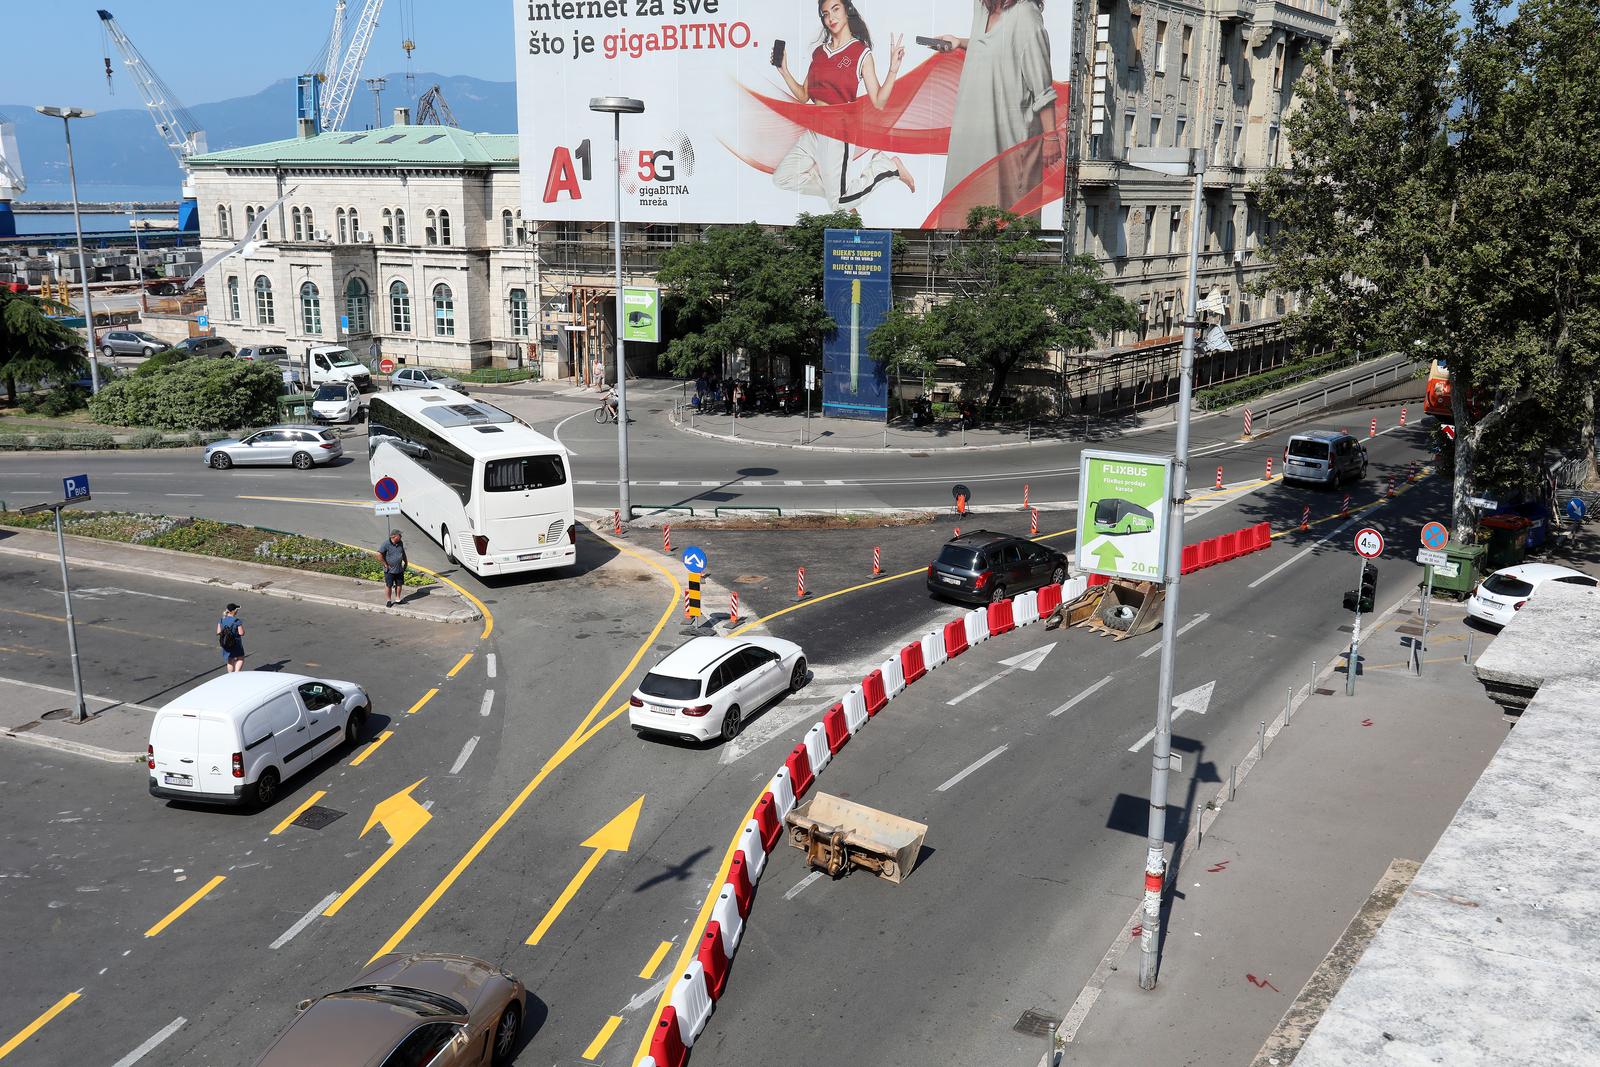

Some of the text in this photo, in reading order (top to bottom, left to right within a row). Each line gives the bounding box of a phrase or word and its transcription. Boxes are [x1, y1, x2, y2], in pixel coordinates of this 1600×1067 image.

[528, 0, 719, 20] internet za sve
[529, 22, 759, 60] što je gigaBITNO.
[543, 138, 592, 204] A1
[637, 150, 675, 182] 5G
[639, 185, 690, 196] gigaBITNA
[639, 196, 669, 207] mreža
[67, 480, 86, 497] P BUS
[1131, 562, 1158, 575] 20 m
